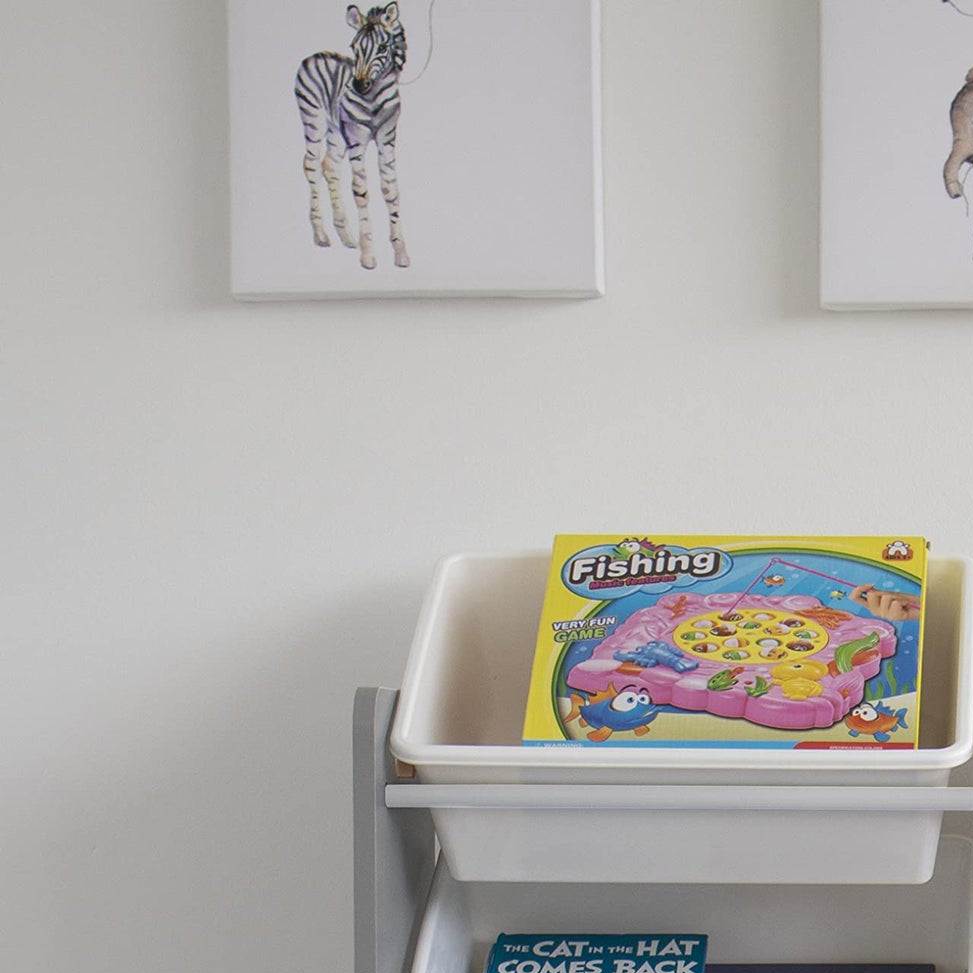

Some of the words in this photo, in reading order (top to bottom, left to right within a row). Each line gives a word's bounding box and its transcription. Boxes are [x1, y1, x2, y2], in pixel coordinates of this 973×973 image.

[570, 549, 720, 584] Fishing
[589, 580, 624, 591] Music
[626, 575, 677, 587] features
[553, 619, 586, 631] VERY
[589, 616, 616, 627] FUN
[555, 627, 606, 642] GAME
[503, 944, 530, 953] THE
[532, 939, 590, 958] CAT
[588, 946, 603, 954] IN
[608, 945, 634, 955] THE
[636, 938, 700, 957] HAT
